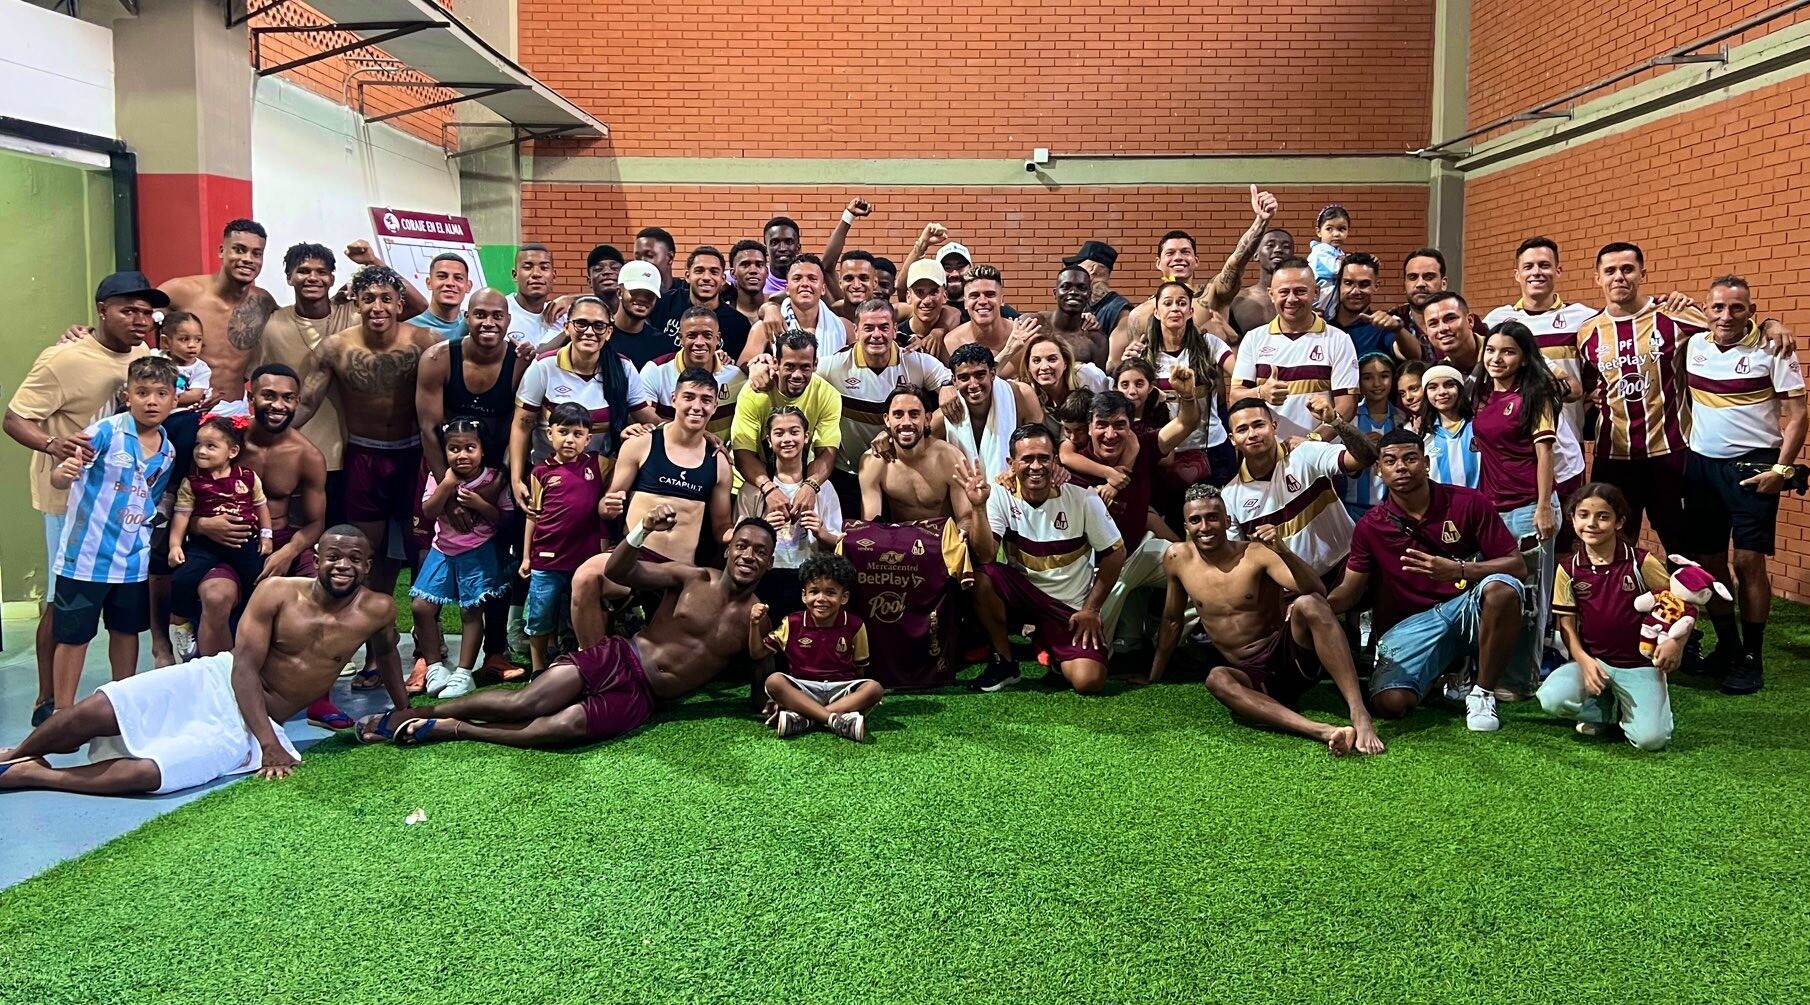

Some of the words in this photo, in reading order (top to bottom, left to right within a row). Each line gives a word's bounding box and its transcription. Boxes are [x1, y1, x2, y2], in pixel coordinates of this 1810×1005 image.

[401, 218, 427, 232] CORAJE
[426, 220, 436, 233] EN
[436, 221, 446, 234] EL
[445, 222, 464, 235] ALMA
[1619, 339, 1632, 351] PF
[1598, 354, 1647, 372] BetPlay
[1617, 370, 1650, 398] Pool
[659, 476, 703, 491] CATAPULT
[857, 572, 909, 588] BetPlay
[868, 592, 907, 618] Pool
